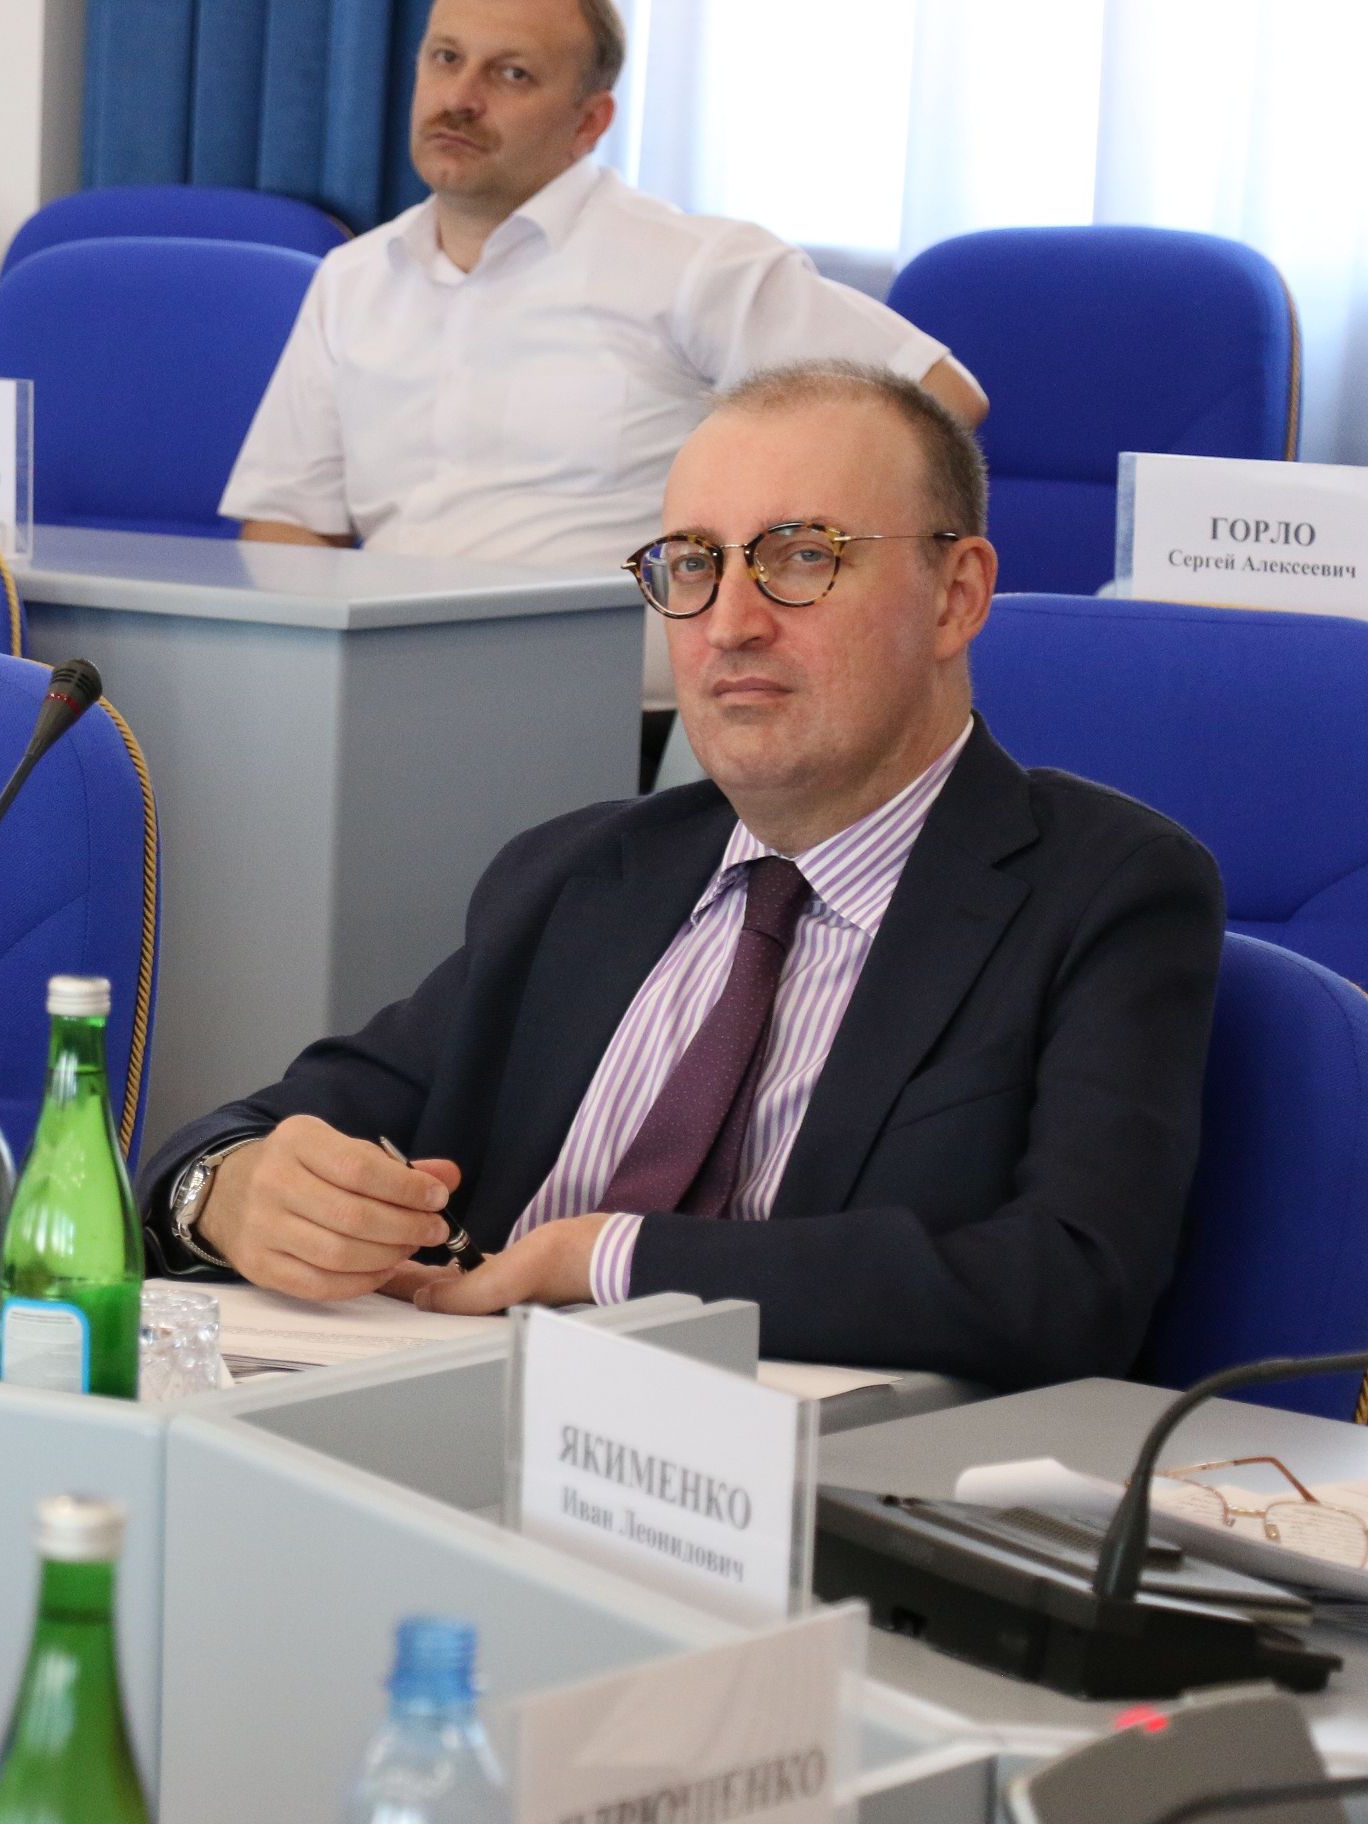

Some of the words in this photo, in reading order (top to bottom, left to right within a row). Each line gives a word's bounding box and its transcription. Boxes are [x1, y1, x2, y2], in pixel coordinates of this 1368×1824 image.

[1168, 549, 1235, 572] Сергей
[1242, 556, 1356, 579] Алексеевич
[1210, 517, 1316, 547] ГОРЛО
[558, 1424, 752, 1531] ЯКИМЕНКО
[561, 1485, 613, 1532] Иван
[619, 1509, 744, 1583] Леонидович
